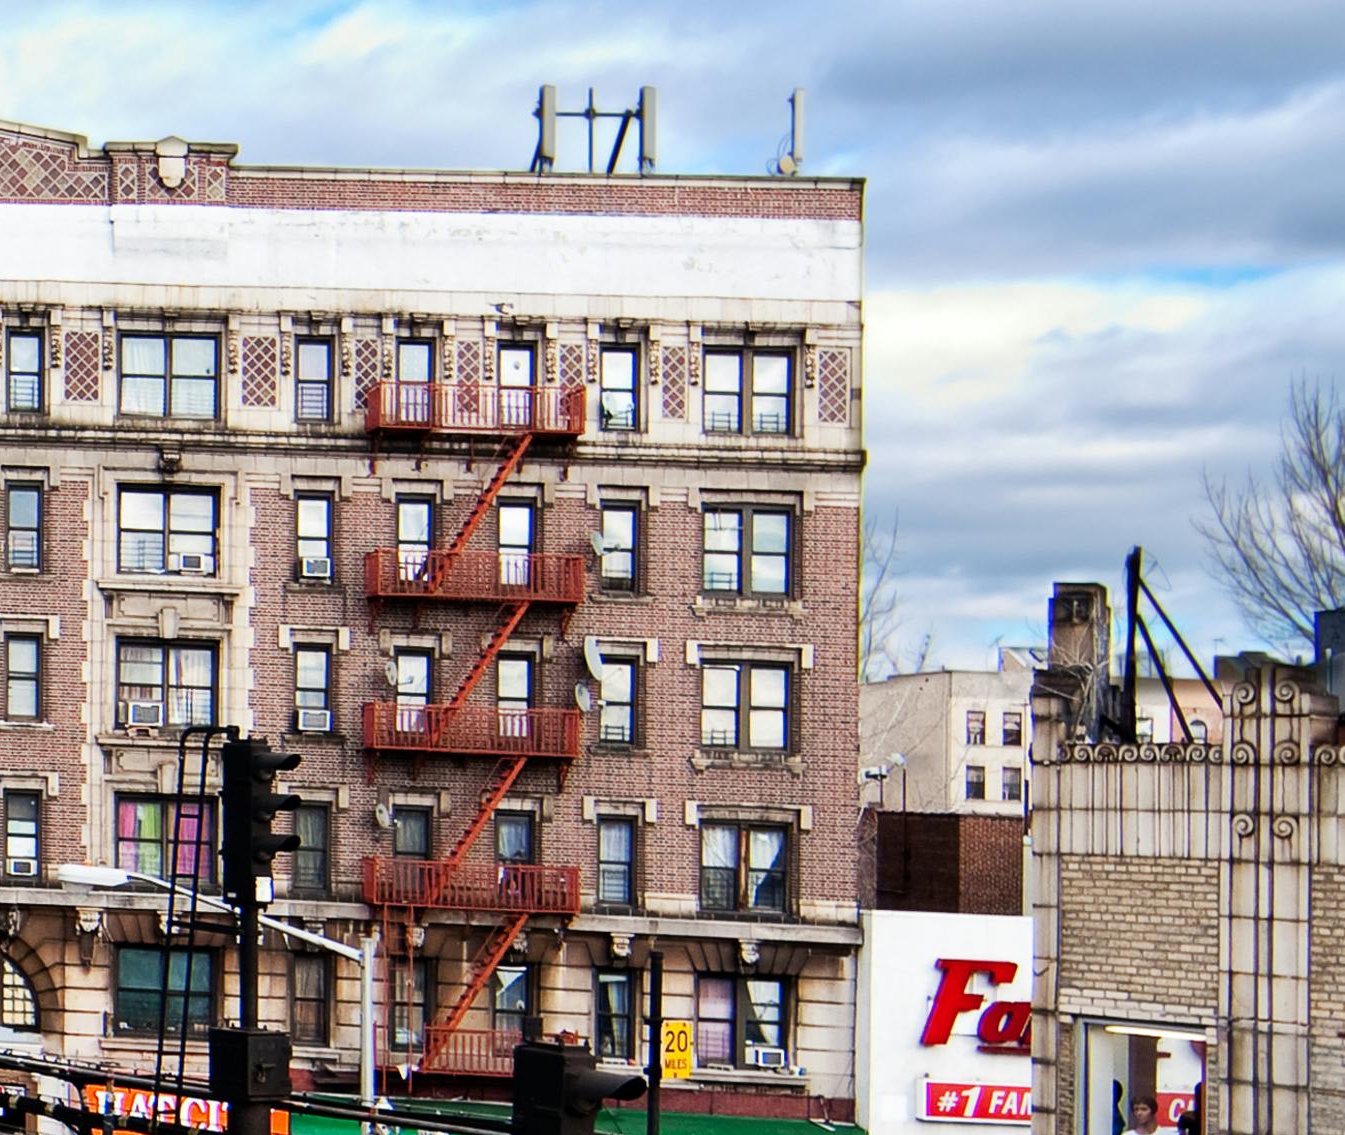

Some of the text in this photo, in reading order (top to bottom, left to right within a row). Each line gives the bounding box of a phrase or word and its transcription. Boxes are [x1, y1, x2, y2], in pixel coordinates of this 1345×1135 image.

[665, 1030, 687, 1052] 20
[665, 1058, 687, 1069] MILES
[937, 1087, 981, 1117] #1
